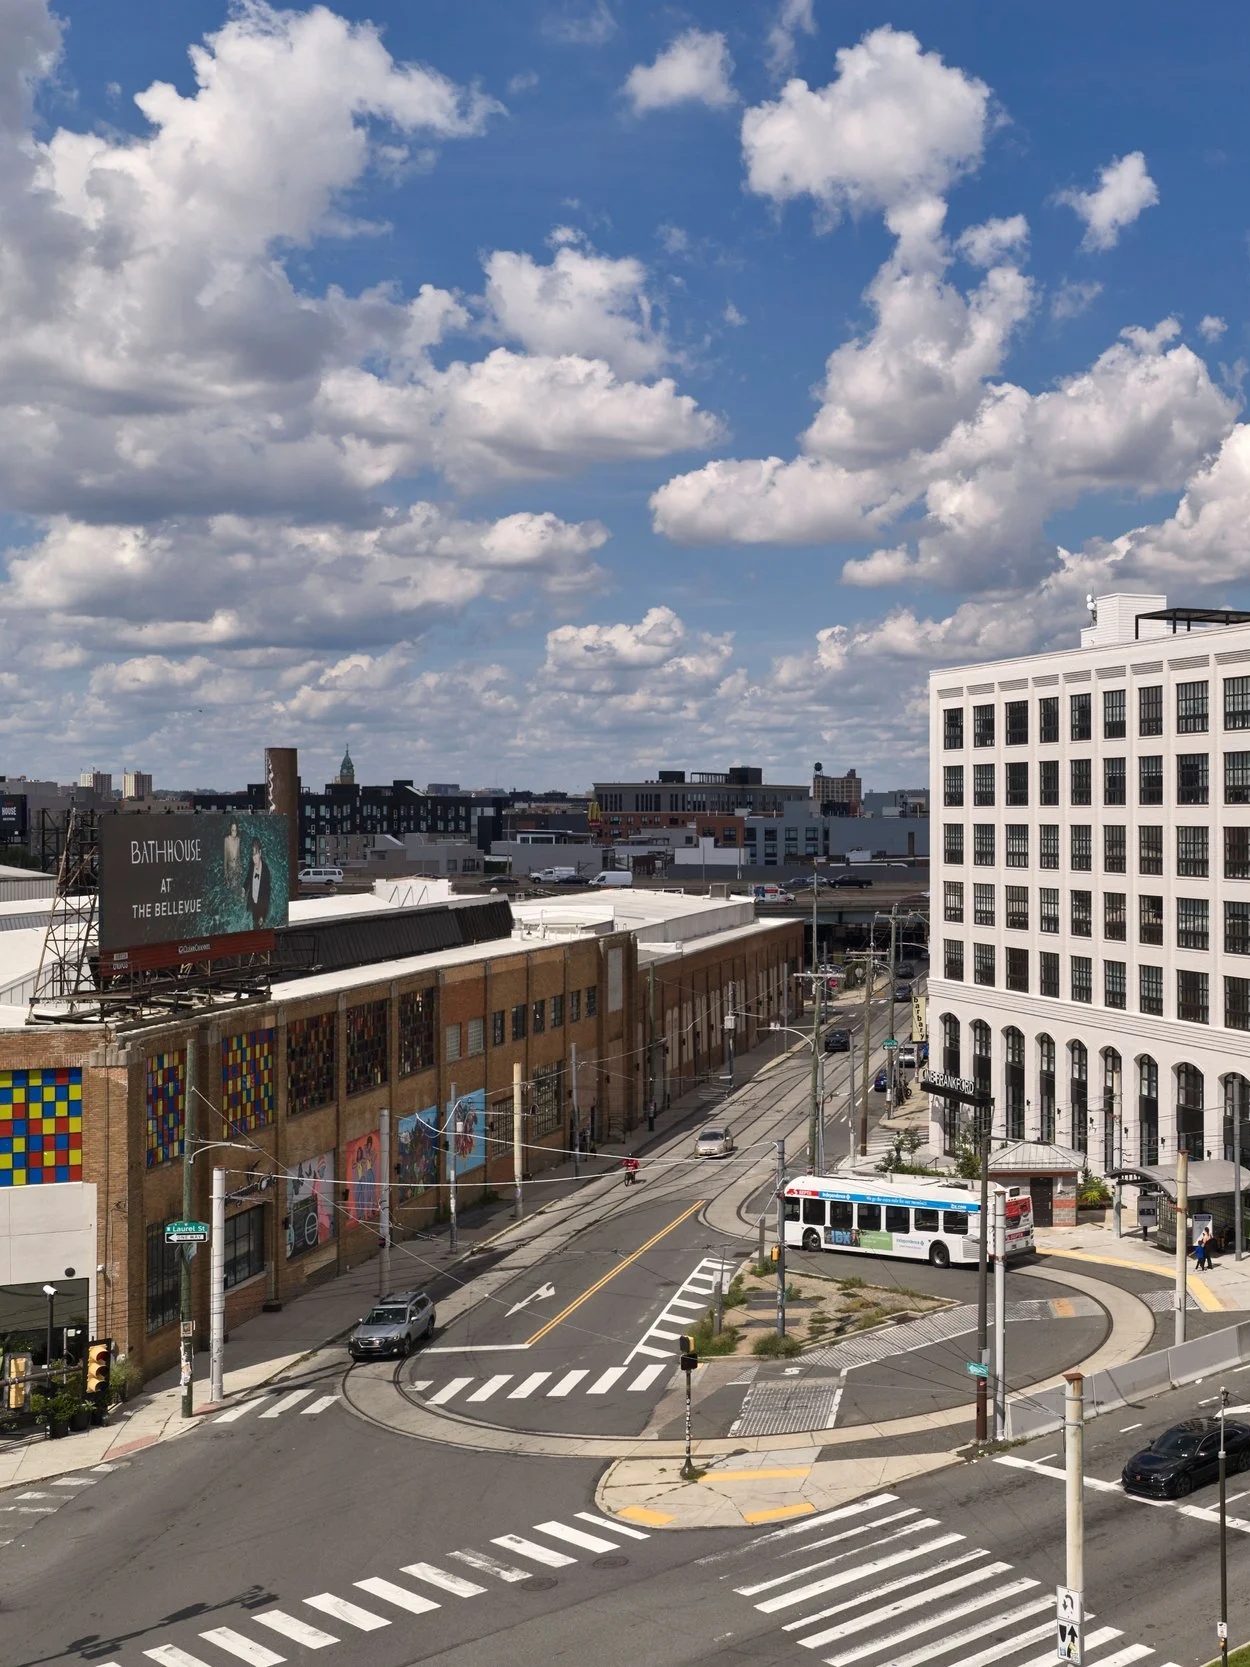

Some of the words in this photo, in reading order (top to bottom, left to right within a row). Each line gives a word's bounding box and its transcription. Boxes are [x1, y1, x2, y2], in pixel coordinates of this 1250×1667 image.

[2, 807, 16, 815] HOUSE
[131, 839, 202, 864] BATHHOUSE
[160, 878, 173, 893] AT
[132, 903, 152, 919] THE
[154, 899, 202, 917] BELLEVUE
[913, 996, 925, 1041] barbary
[935, 1073, 975, 1095] FRANKFORD
